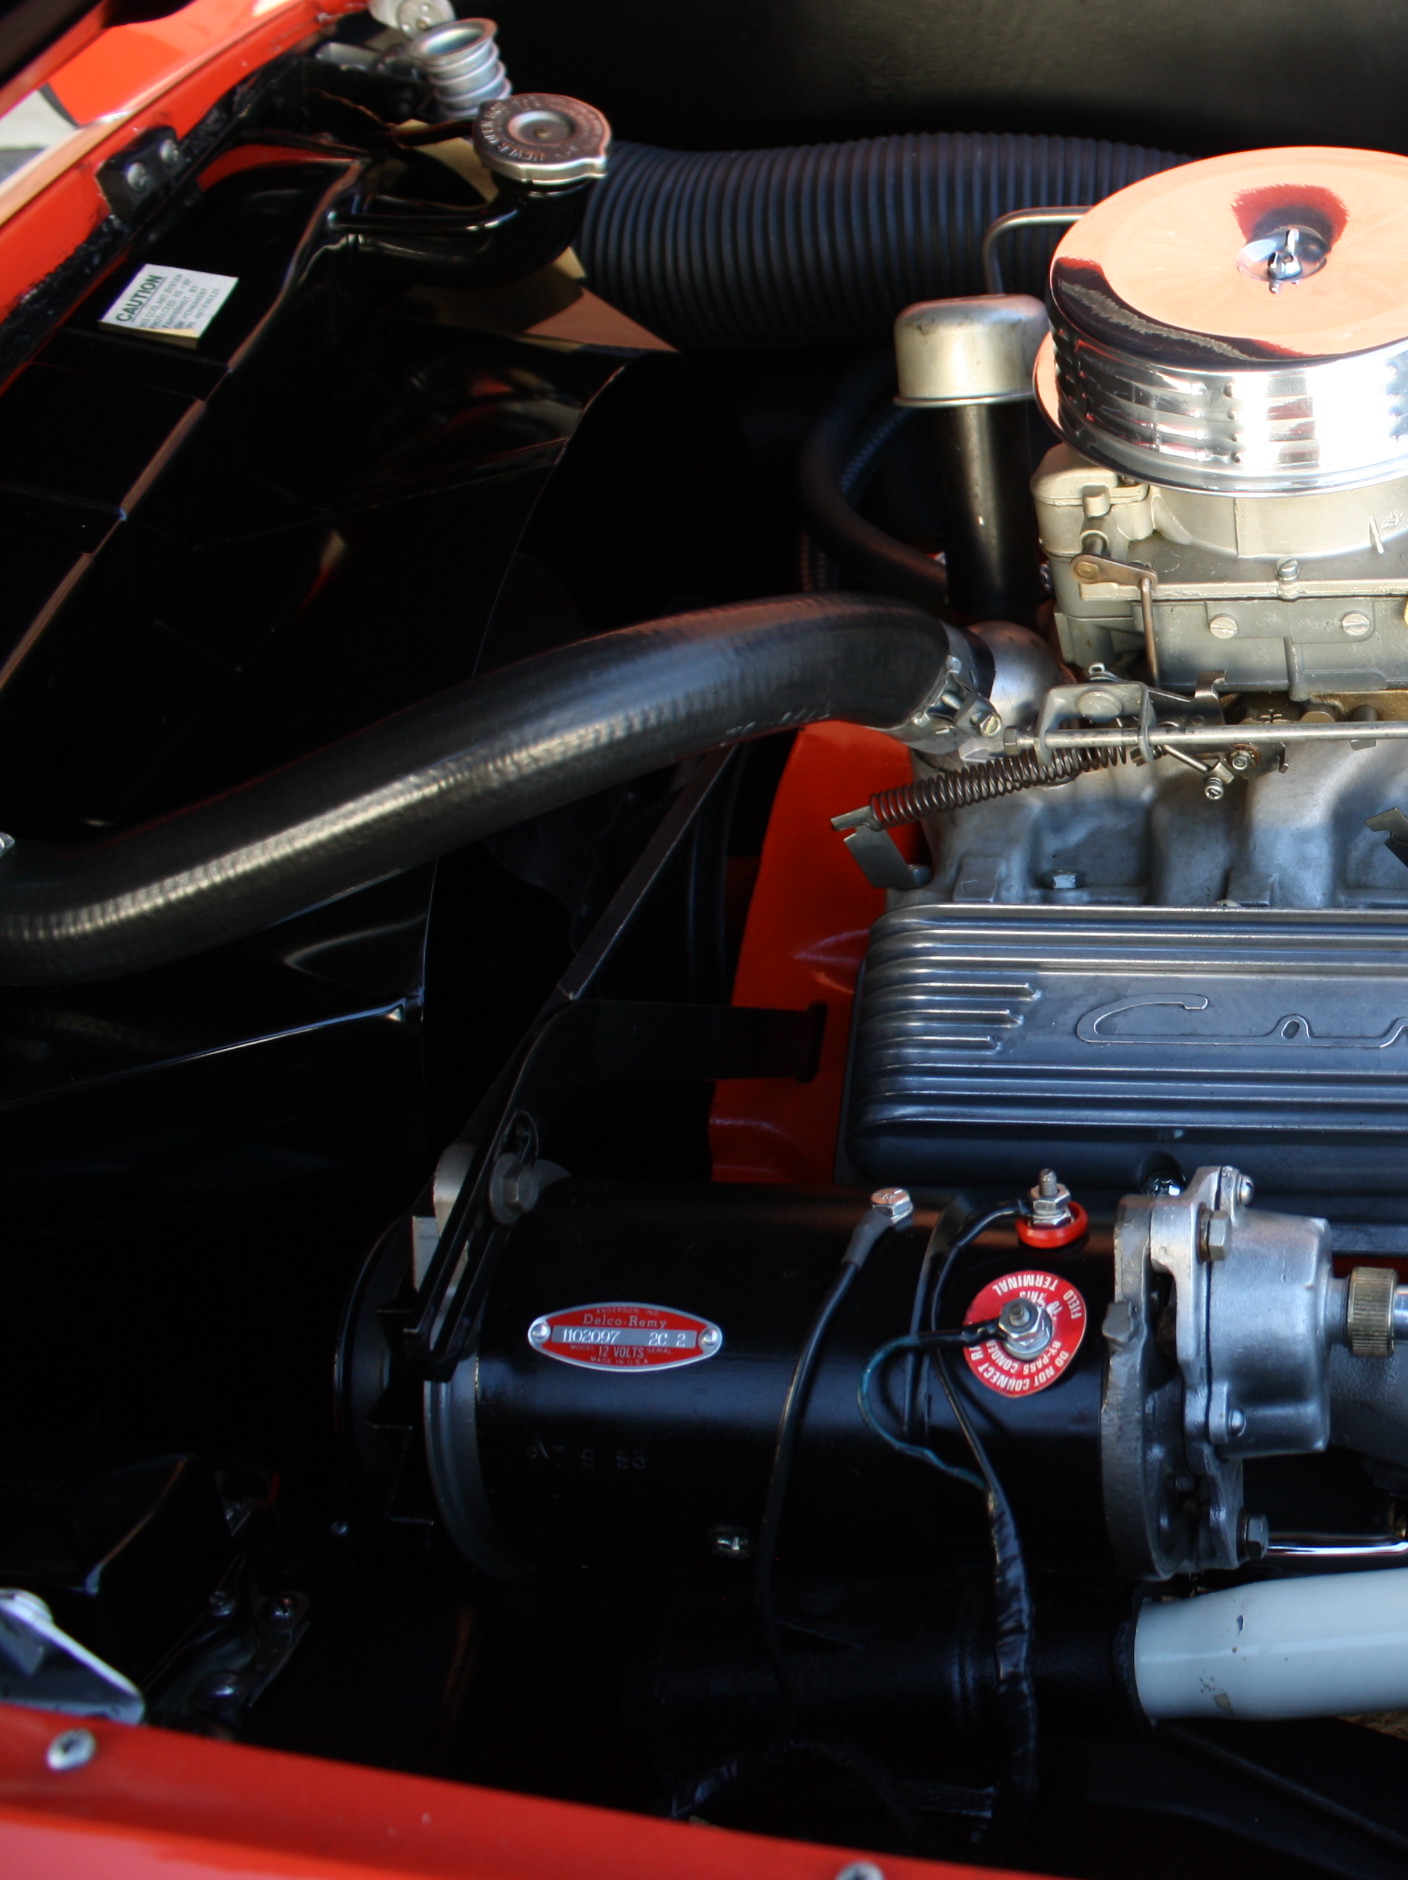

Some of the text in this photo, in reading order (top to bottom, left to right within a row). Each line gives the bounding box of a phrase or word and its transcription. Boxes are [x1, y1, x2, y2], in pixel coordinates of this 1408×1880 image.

[116, 274, 163, 322] CAUTION
[992, 1274, 1083, 1320] FIELD TERMINAL
[582, 1313, 668, 1330] Delco-Remy
[562, 1328, 620, 1344] 1102097
[598, 1345, 645, 1359] 12 VOLTS
[1023, 1340, 1062, 1375] BY-PASS
[1055, 1351, 1069, 1368] DO
[977, 1362, 1030, 1392] CONNECT
[1033, 1367, 1055, 1388] NOT
